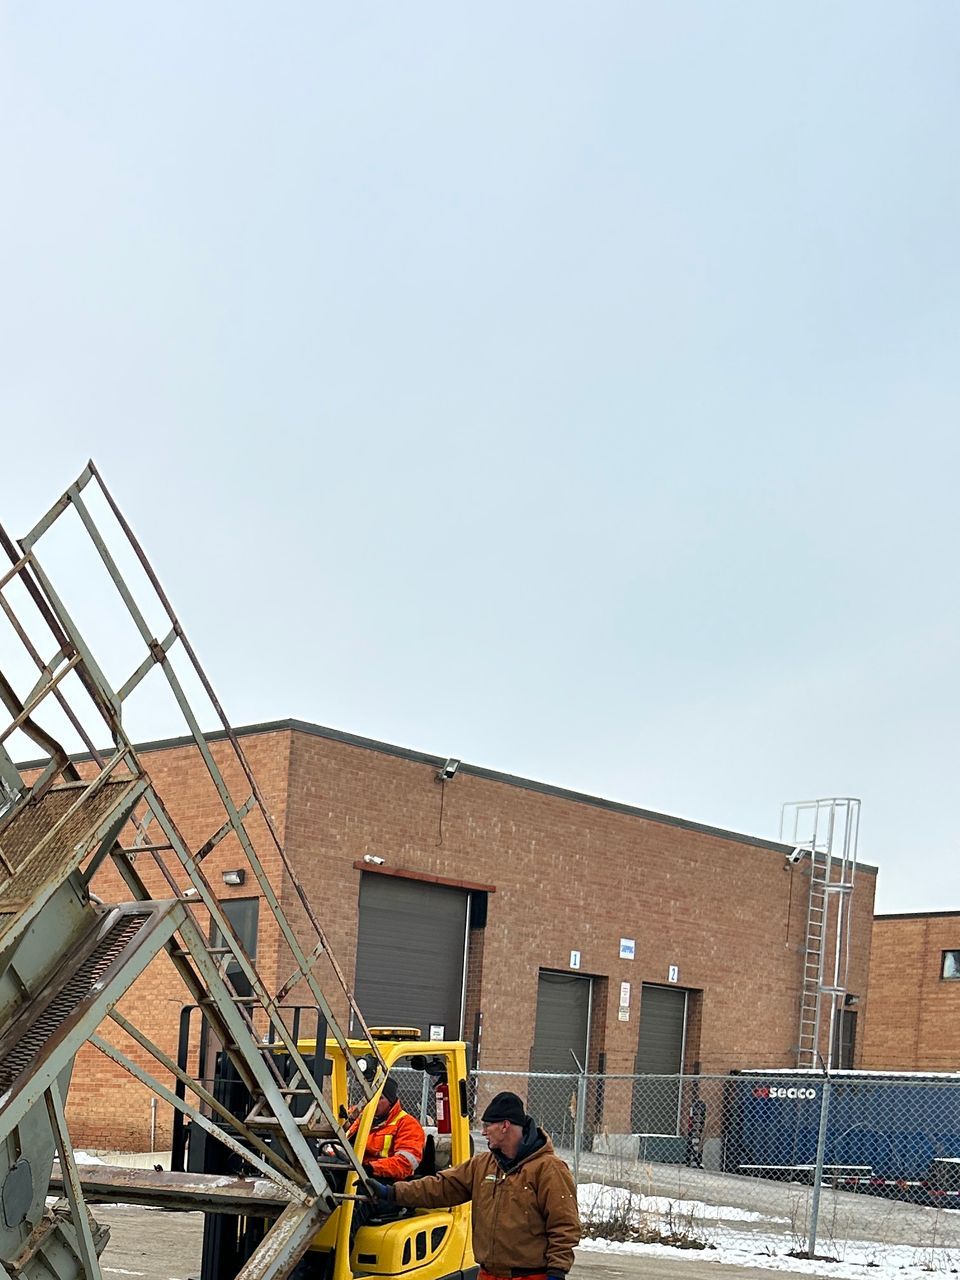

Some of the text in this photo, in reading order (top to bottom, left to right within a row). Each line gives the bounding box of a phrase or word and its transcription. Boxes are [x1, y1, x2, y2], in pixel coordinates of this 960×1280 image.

[572, 953, 577, 966] 1
[671, 967, 676, 981] 2
[768, 1086, 816, 1100] seaco
